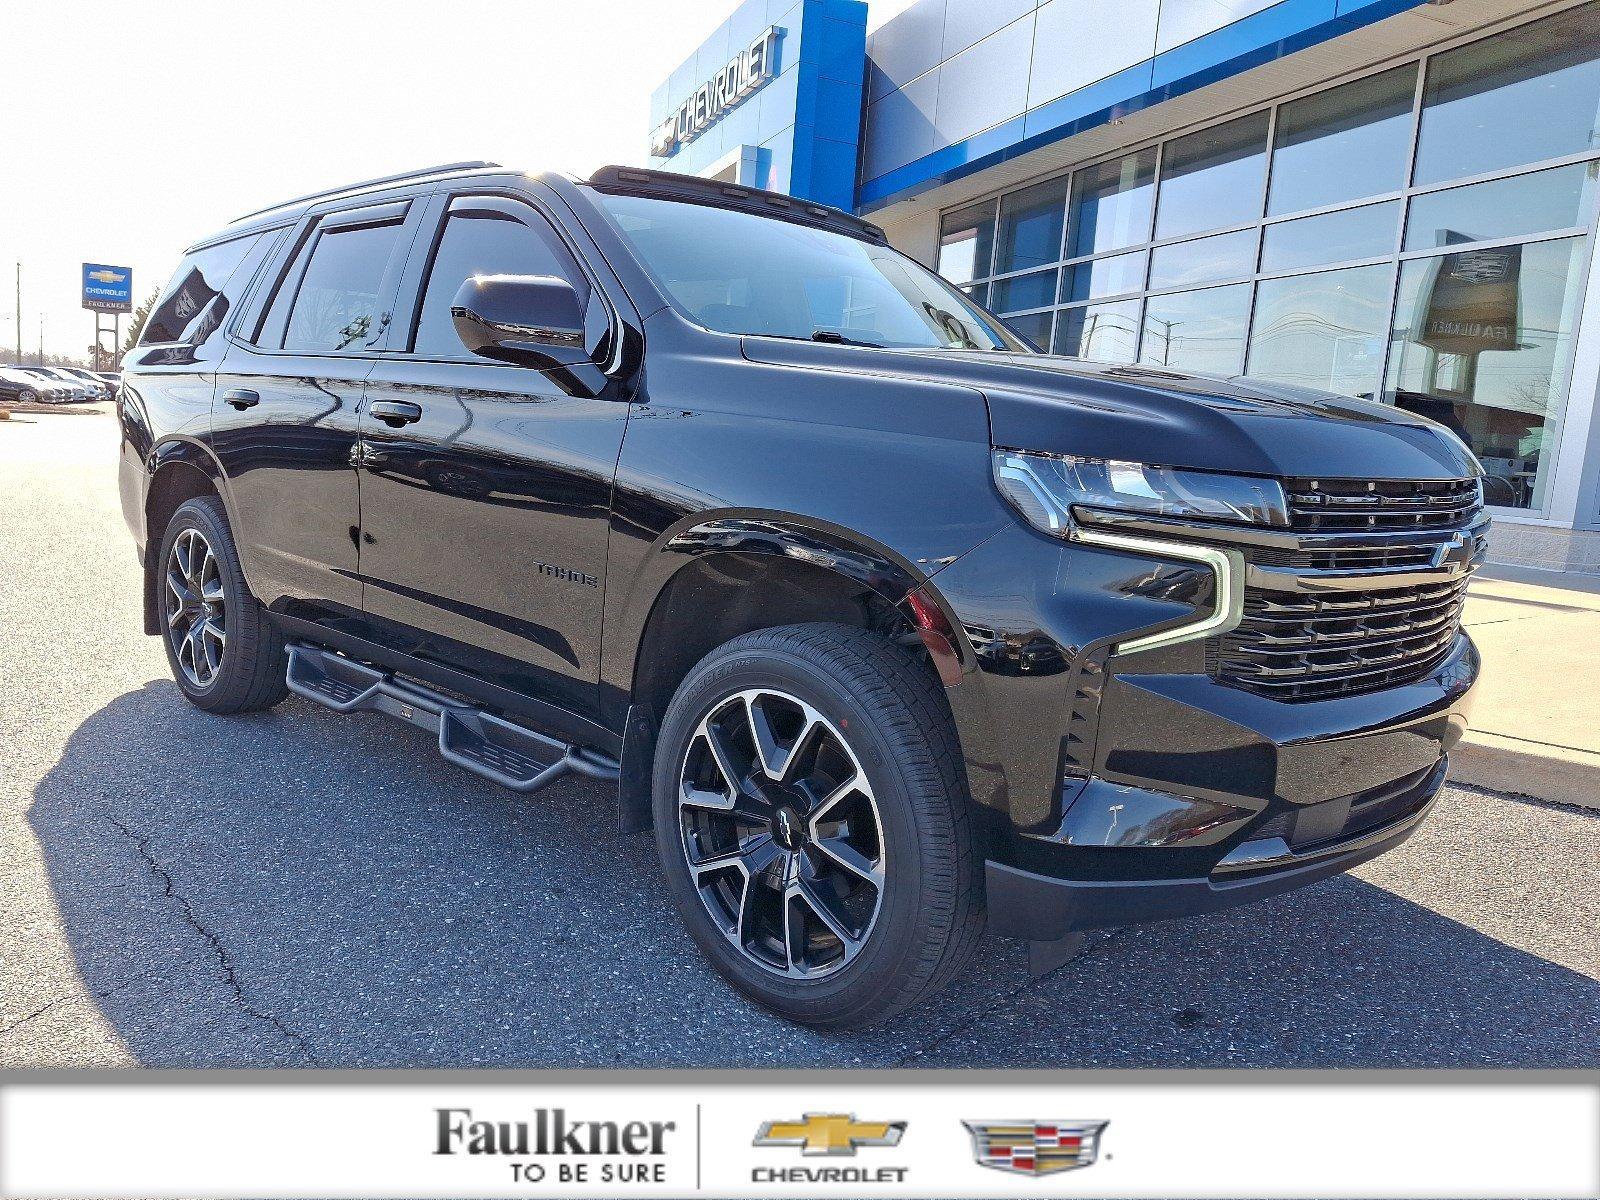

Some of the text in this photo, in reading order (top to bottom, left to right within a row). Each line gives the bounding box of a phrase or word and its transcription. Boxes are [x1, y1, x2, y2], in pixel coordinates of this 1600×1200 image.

[677, 25, 778, 142] CHEVROLET
[85, 287, 128, 296] CHEVROLET
[533, 560, 598, 588] TAHOE
